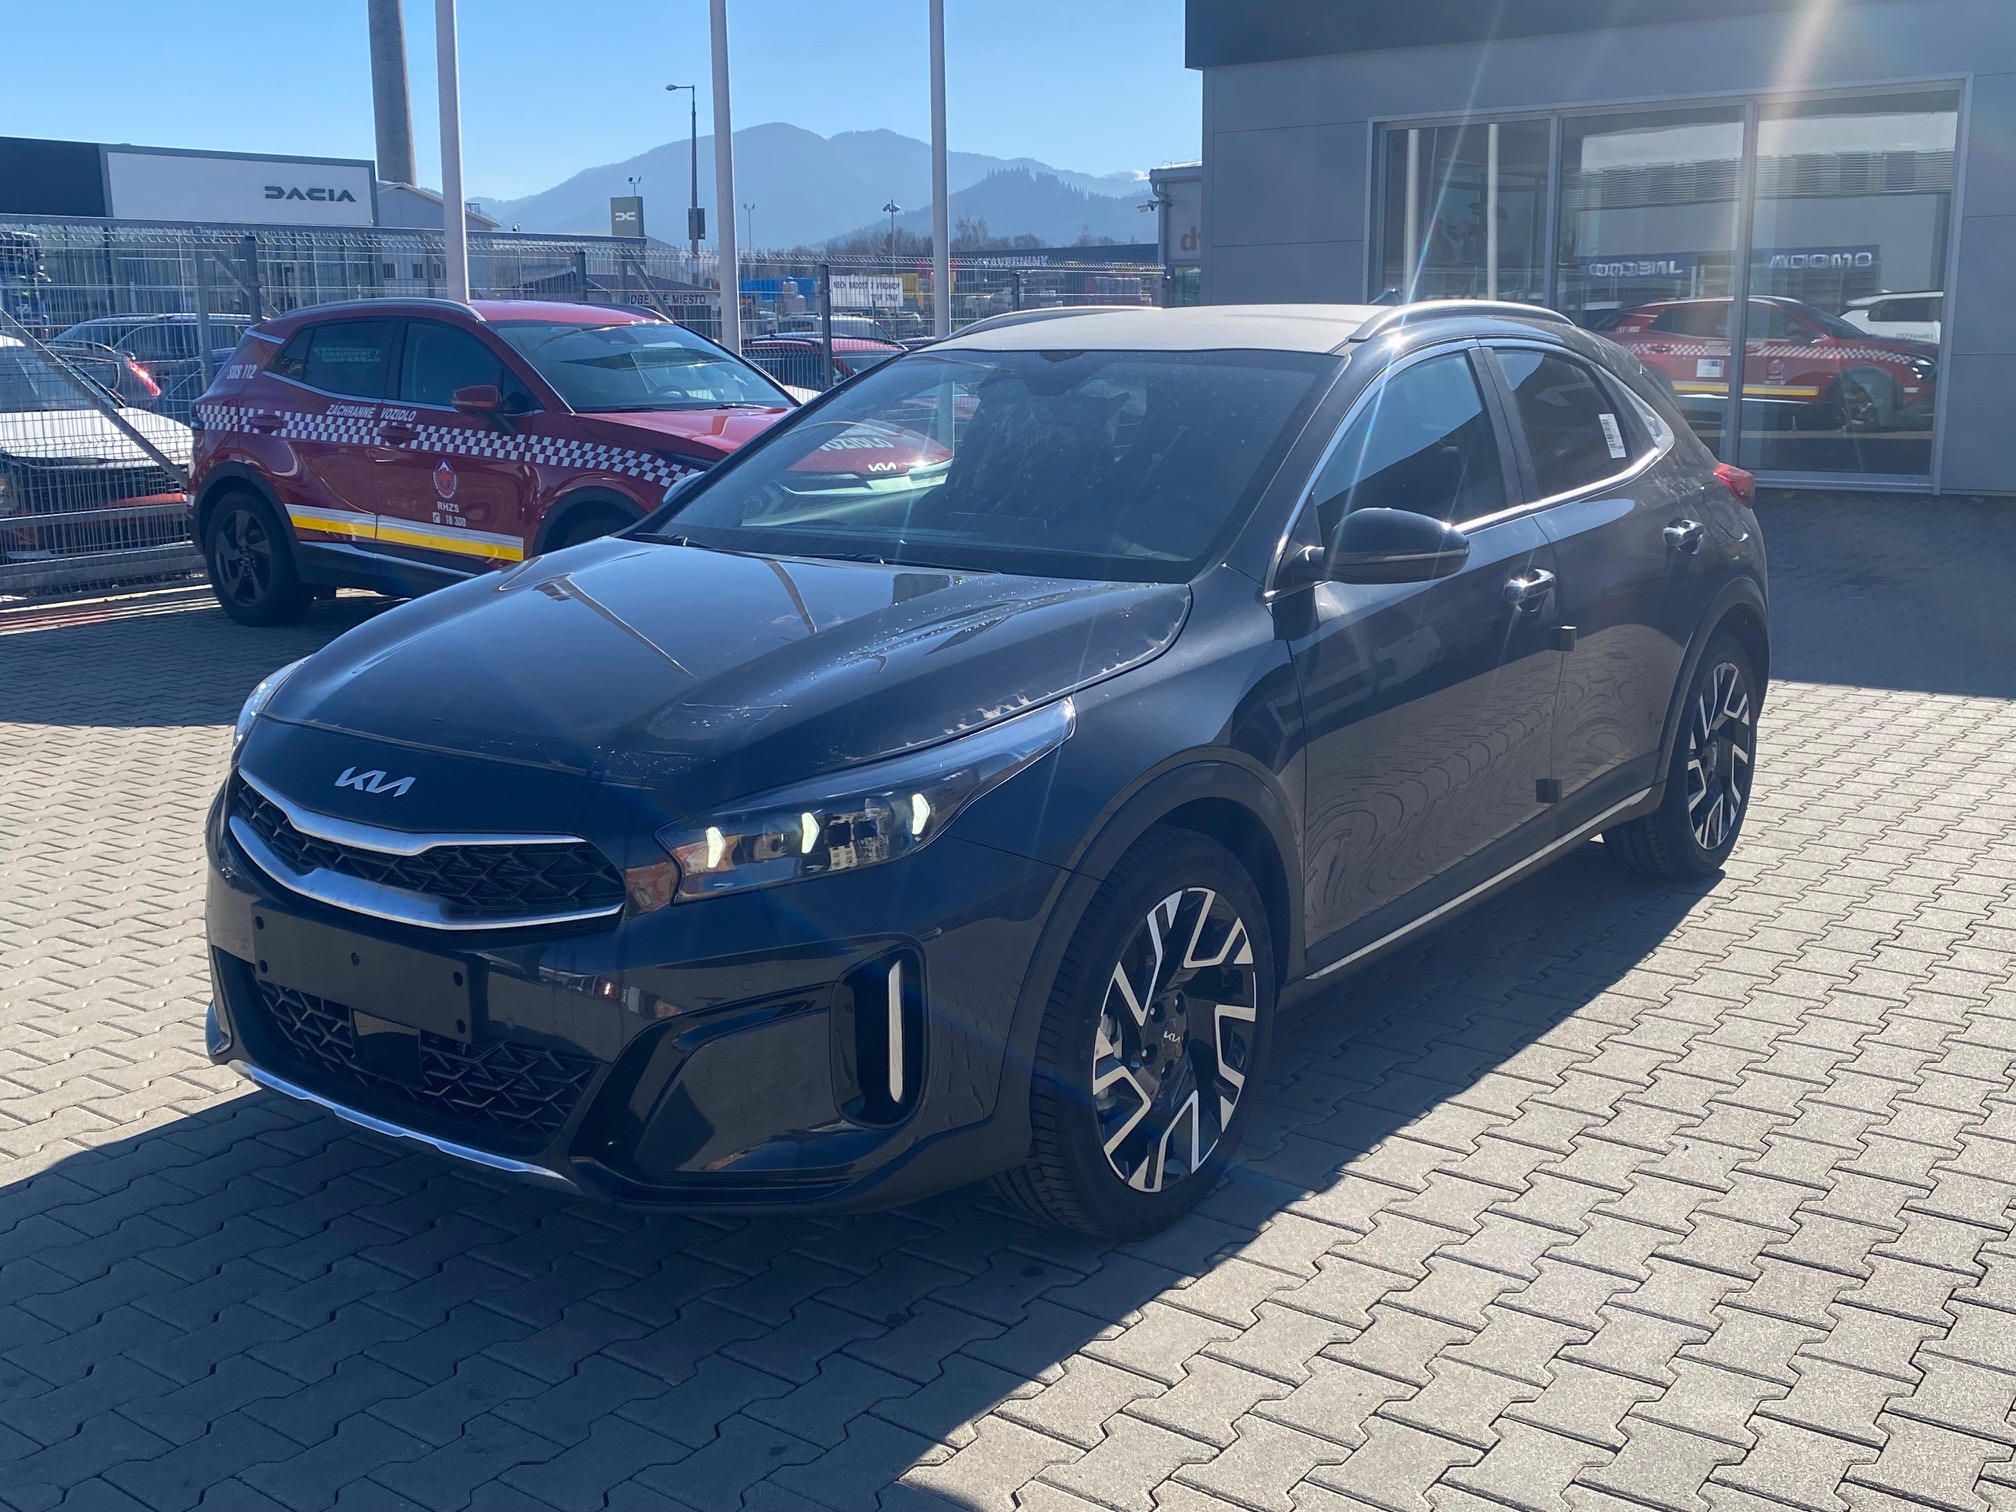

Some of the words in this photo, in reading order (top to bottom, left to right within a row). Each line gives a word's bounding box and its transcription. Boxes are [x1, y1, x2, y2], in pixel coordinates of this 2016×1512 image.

[264, 185, 356, 203] DACIA
[671, 294, 706, 304] MIESTO
[242, 364, 258, 380] 112
[326, 402, 377, 419] ZÁCHRANNÉ
[380, 407, 417, 422] VOZIDLO
[437, 501, 460, 513] RHZS
[445, 514, 453, 525] 18
[454, 516, 467, 527] 300
[334, 766, 416, 798] KIA
